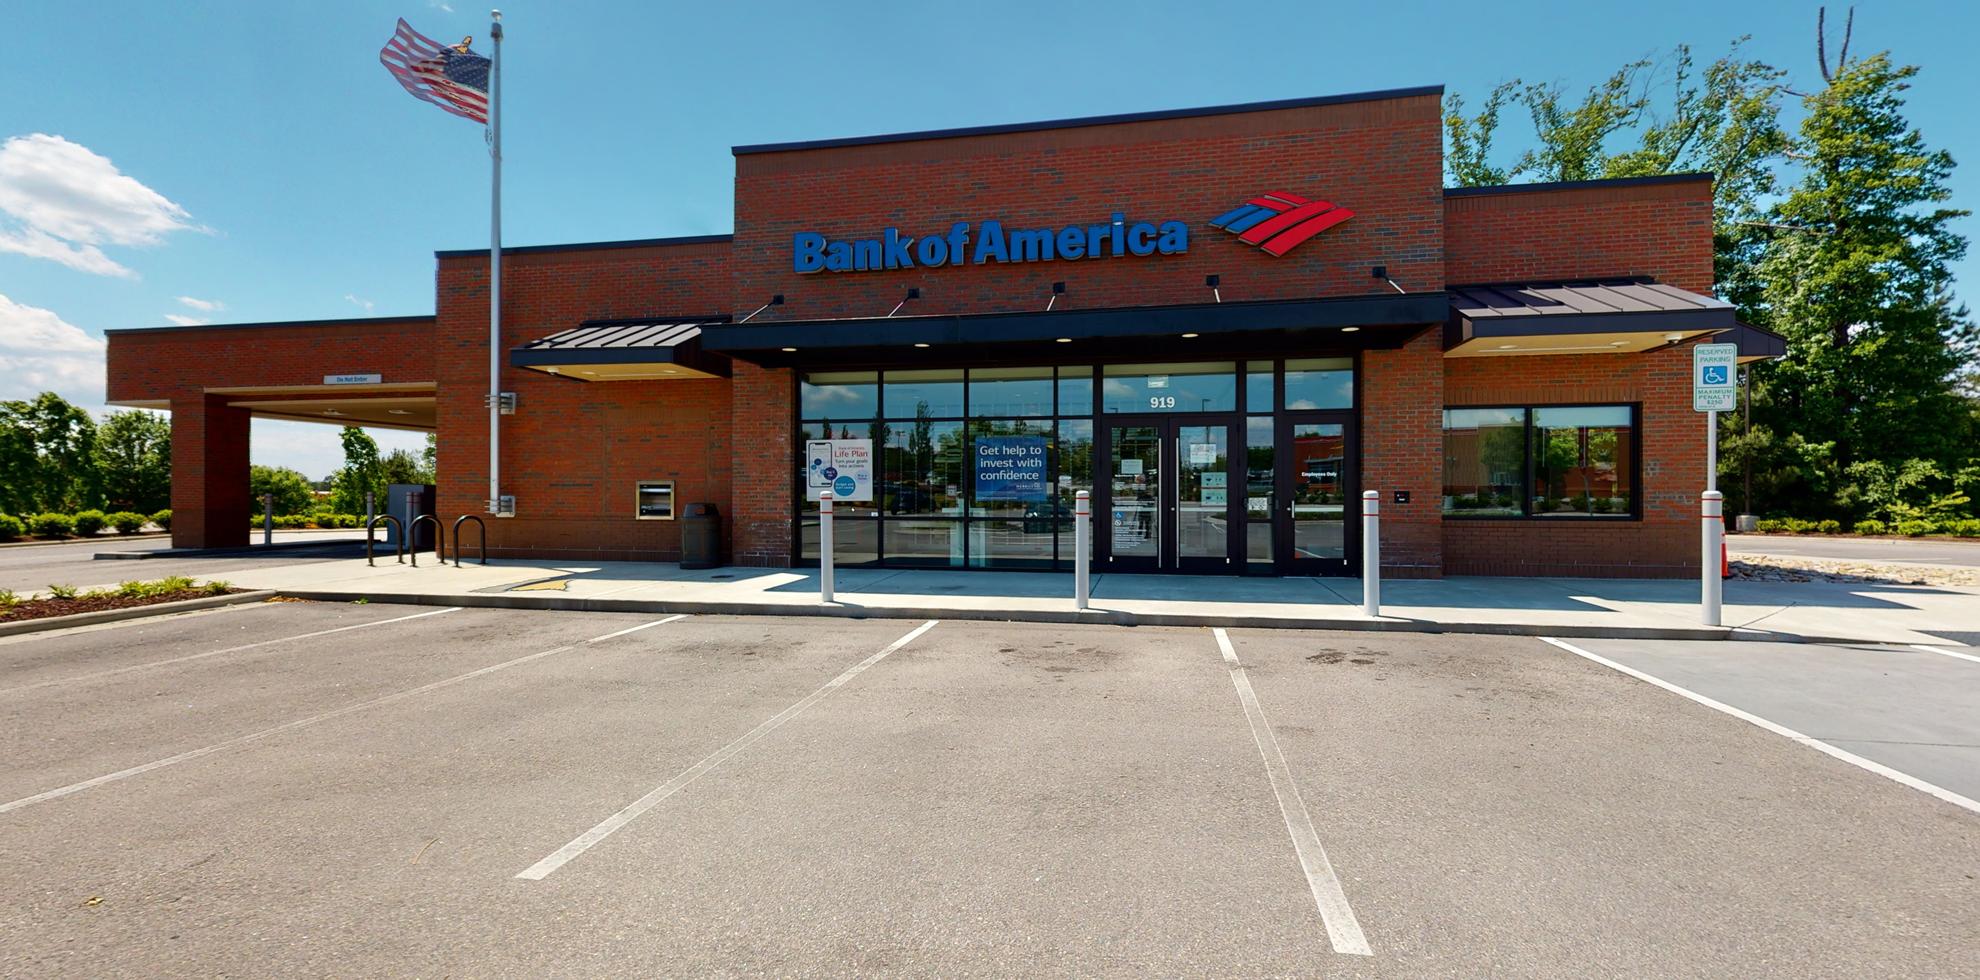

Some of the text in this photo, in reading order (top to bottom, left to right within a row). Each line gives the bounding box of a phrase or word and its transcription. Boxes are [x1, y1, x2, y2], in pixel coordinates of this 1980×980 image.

[793, 212, 1189, 274] Bank of America
[1150, 396, 1176, 409] 919
[834, 450, 868, 458] Life Plan
[979, 444, 1042, 457] Get help to
[980, 457, 1042, 468] invest with
[980, 469, 1039, 481] confidence
